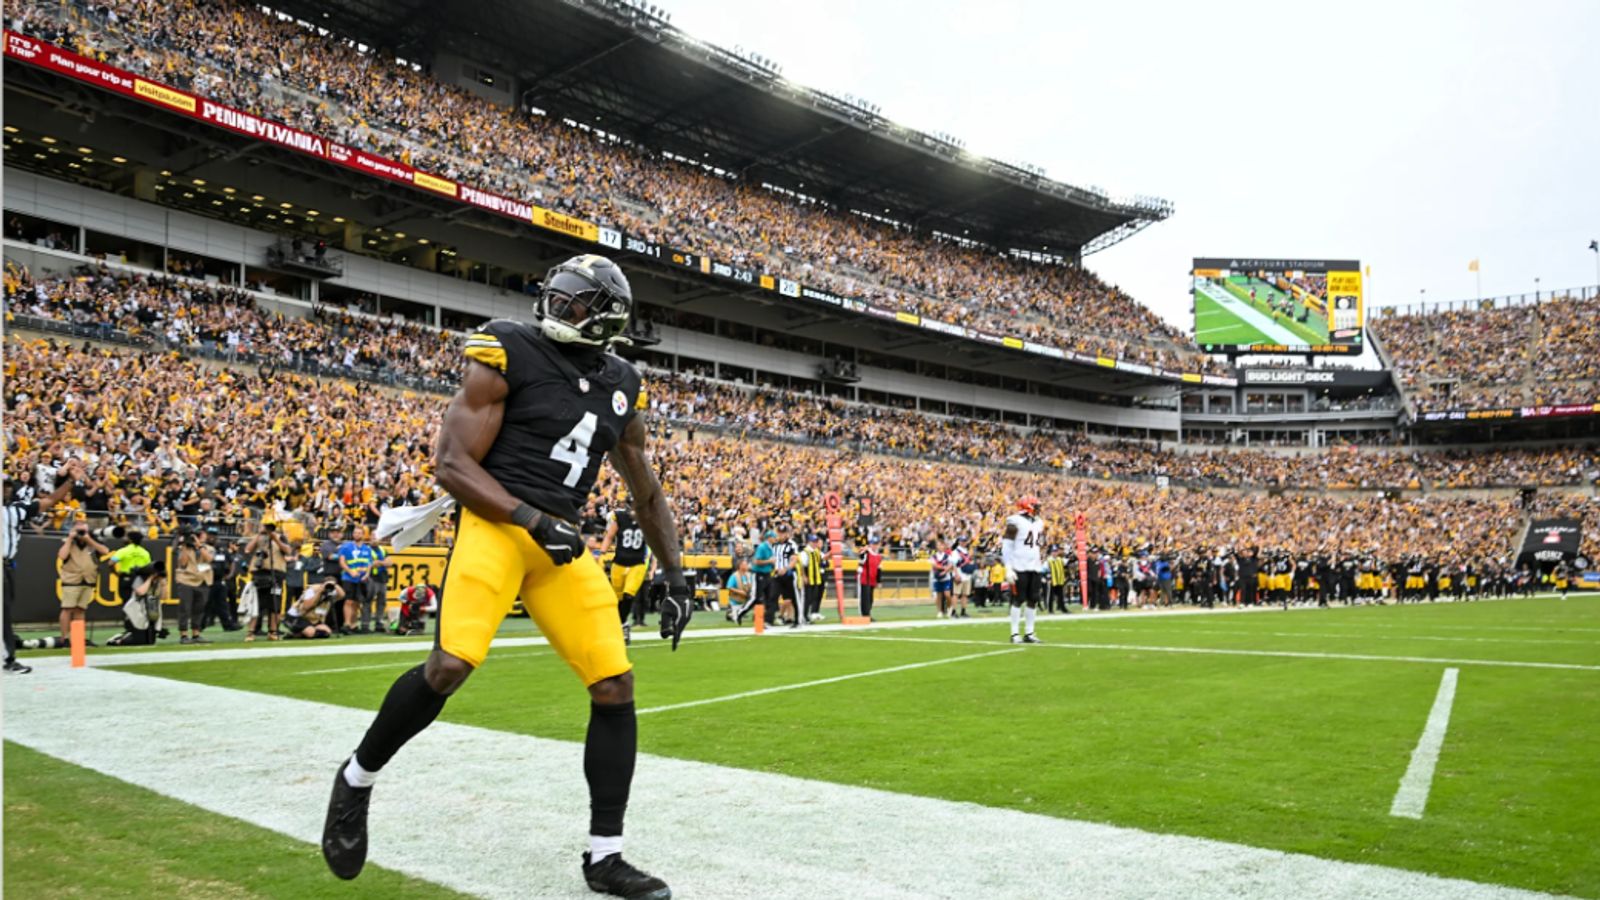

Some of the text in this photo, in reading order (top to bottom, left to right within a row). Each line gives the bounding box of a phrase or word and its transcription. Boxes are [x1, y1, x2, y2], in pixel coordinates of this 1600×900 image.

[10, 45, 35, 58] TRIP
[33, 44, 41, 53] A
[50, 54, 74, 69] Plan
[75, 64, 100, 76] your
[101, 71, 120, 84] trip
[138, 84, 193, 108] visitpa.com
[203, 101, 324, 155] PENNSYLVANIA
[543, 212, 584, 236] Steelers
[604, 231, 617, 244] 17
[626, 238, 646, 253] 3RD
[655, 246, 660, 258] 1
[685, 255, 692, 266] 5
[713, 262, 732, 277] 3RD
[1247, 372, 1271, 381] BUD
[1272, 372, 1303, 381] LIGHT
[1305, 372, 1334, 382] DECK
[550, 411, 598, 488] 4
[861, 498, 871, 516] 3
[622, 528, 643, 549] 88
